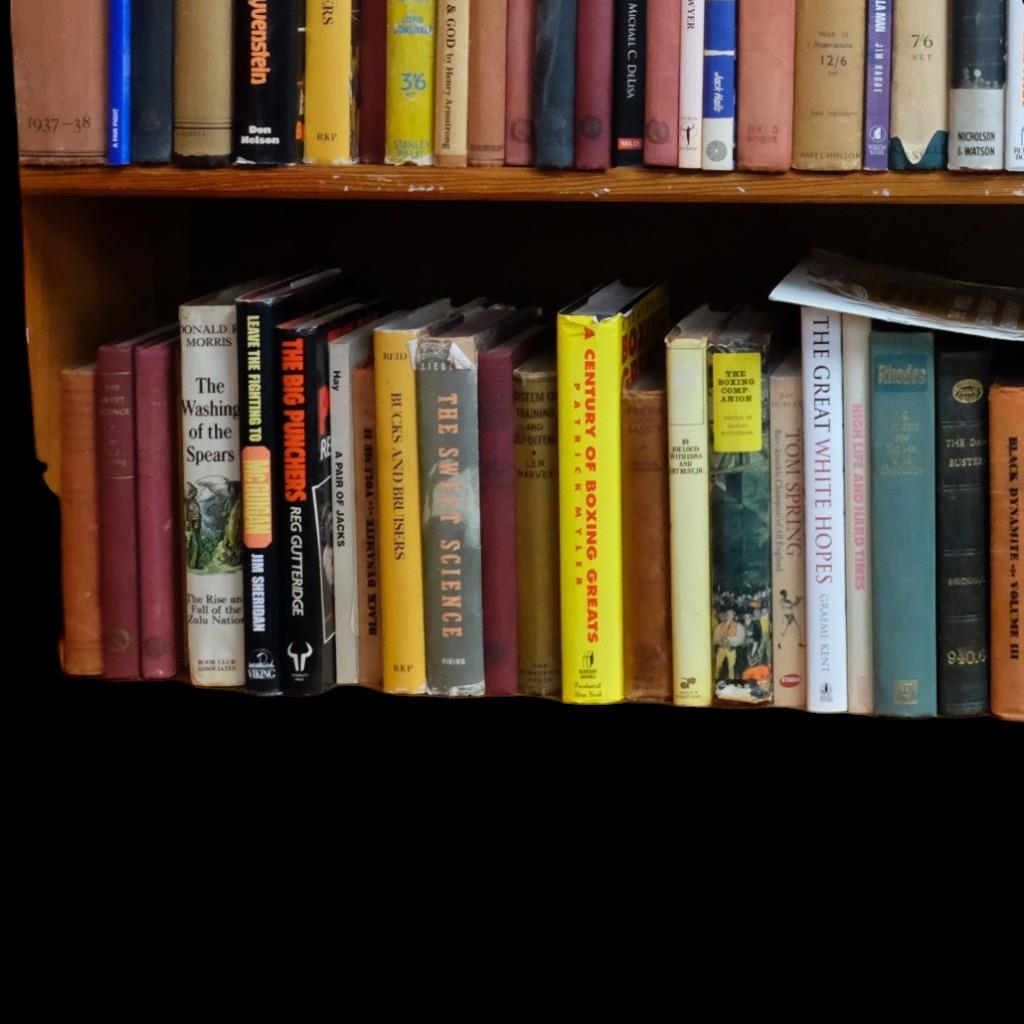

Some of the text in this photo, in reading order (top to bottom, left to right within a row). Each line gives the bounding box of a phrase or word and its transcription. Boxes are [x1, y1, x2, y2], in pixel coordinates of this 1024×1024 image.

[186, 337, 232, 347] MORRIS
[195, 377, 225, 394] The
[182, 399, 239, 420] Washing
[186, 446, 235, 465] Spears
[189, 423, 232, 439] of the
[281, 338, 307, 502] THE BIG PUNCHERS
[812, 317, 833, 584] THE GREAT WHITE HOPES
[335, 451, 346, 548] A PAIR OF JACKS
[584, 327, 599, 644] A CENTURY OF BOXING GREATS
[290, 506, 304, 617] REG GUTTERIDGE
[440, 538, 463, 638] SCIENCE
